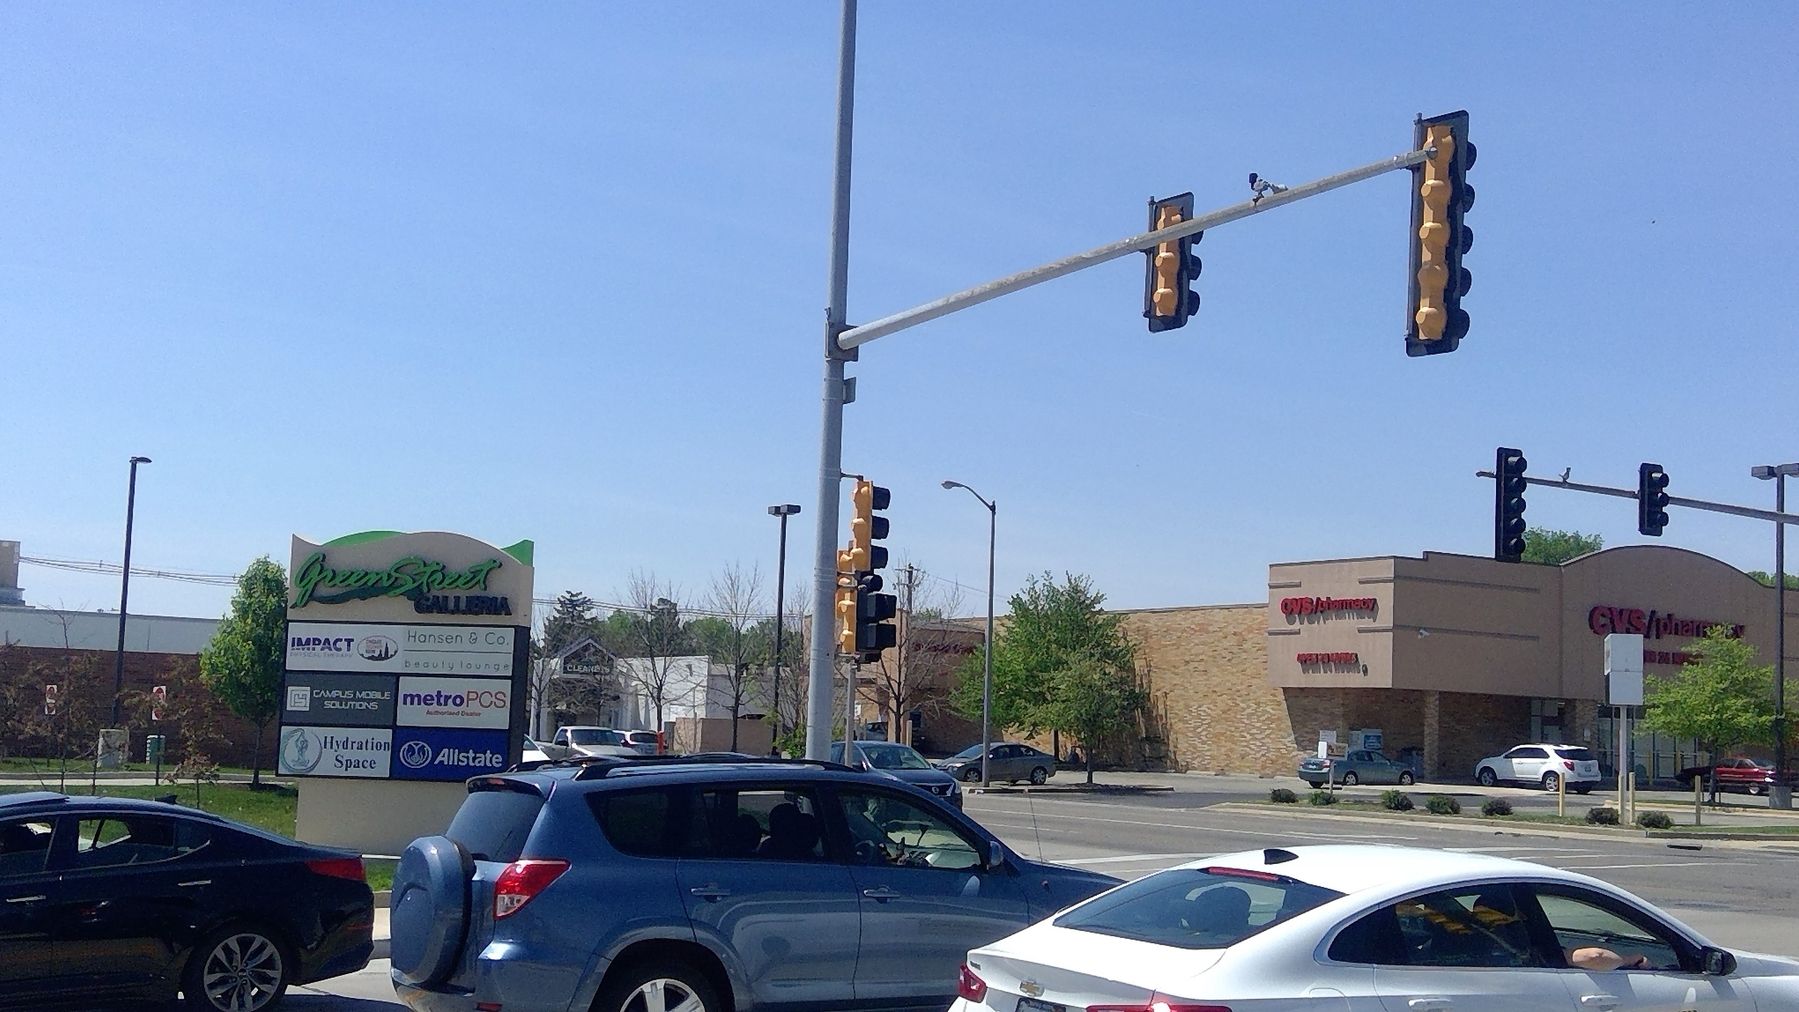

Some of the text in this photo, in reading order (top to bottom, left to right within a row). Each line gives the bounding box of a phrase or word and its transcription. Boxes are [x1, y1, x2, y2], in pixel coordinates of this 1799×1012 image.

[413, 595, 512, 616] GALLERIA
[1589, 606, 1745, 639] CVS/phary
[291, 637, 355, 652] IMPACT
[407, 630, 510, 645] Hansen & Co.
[404, 660, 510, 672] beauty lounge
[313, 689, 391, 700] CAMPUS MOBILE
[402, 689, 507, 709] metroPCS
[323, 700, 379, 710] SOLUTIONS
[323, 736, 390, 752] Hydration
[334, 754, 377, 772] Space
[434, 748, 503, 768] Allstate
